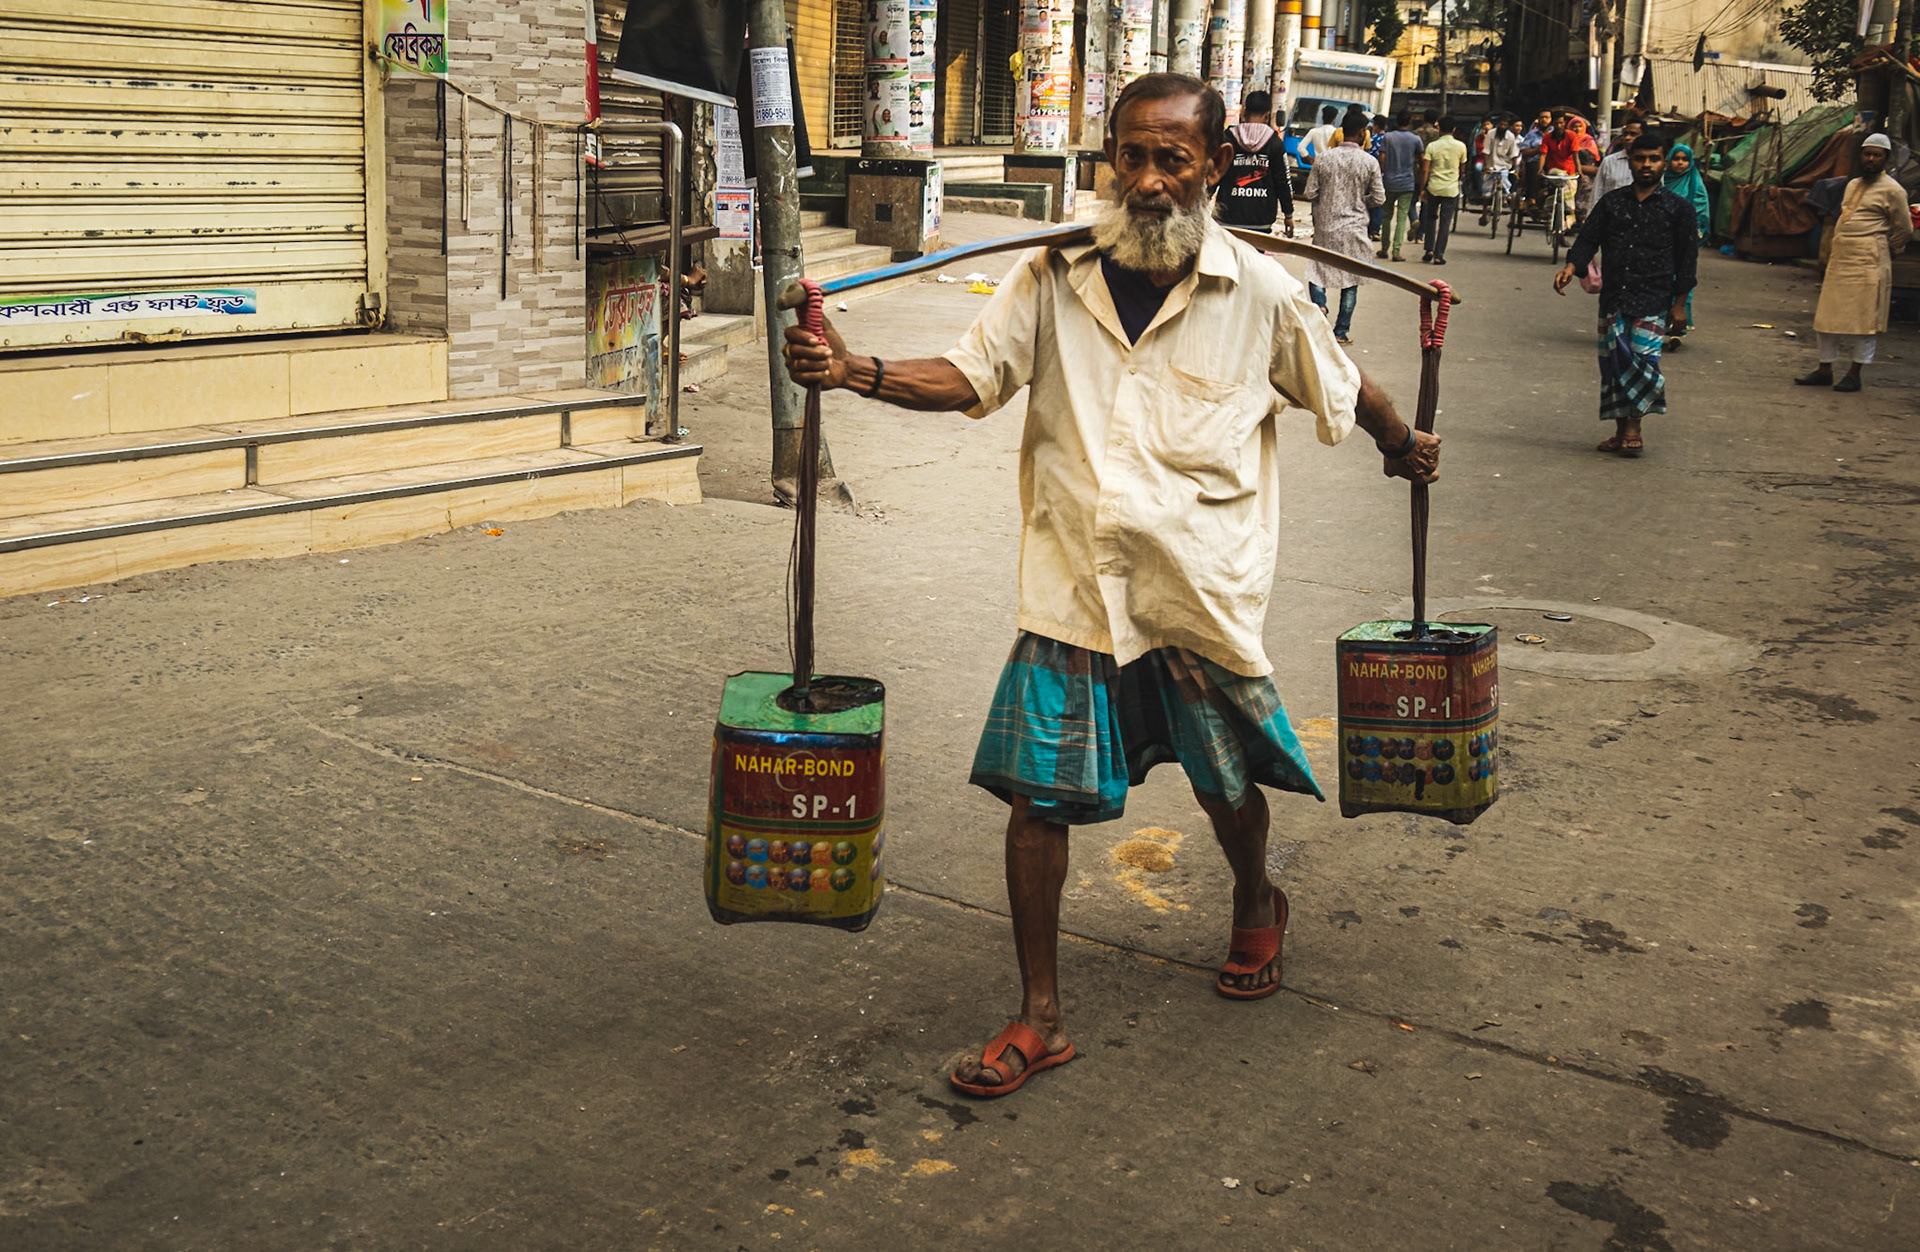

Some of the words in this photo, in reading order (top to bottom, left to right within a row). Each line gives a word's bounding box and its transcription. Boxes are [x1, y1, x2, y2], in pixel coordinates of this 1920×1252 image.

[1231, 187, 1268, 198] BRONX
[102, 299, 141, 314] এন্ড
[204, 295, 247, 314] ফুড
[1349, 662, 1448, 681] NAHAR-BOND
[1396, 695, 1451, 719] SP-1
[735, 754, 855, 777] NAHAR-BOND
[792, 794, 857, 819] SP-1
